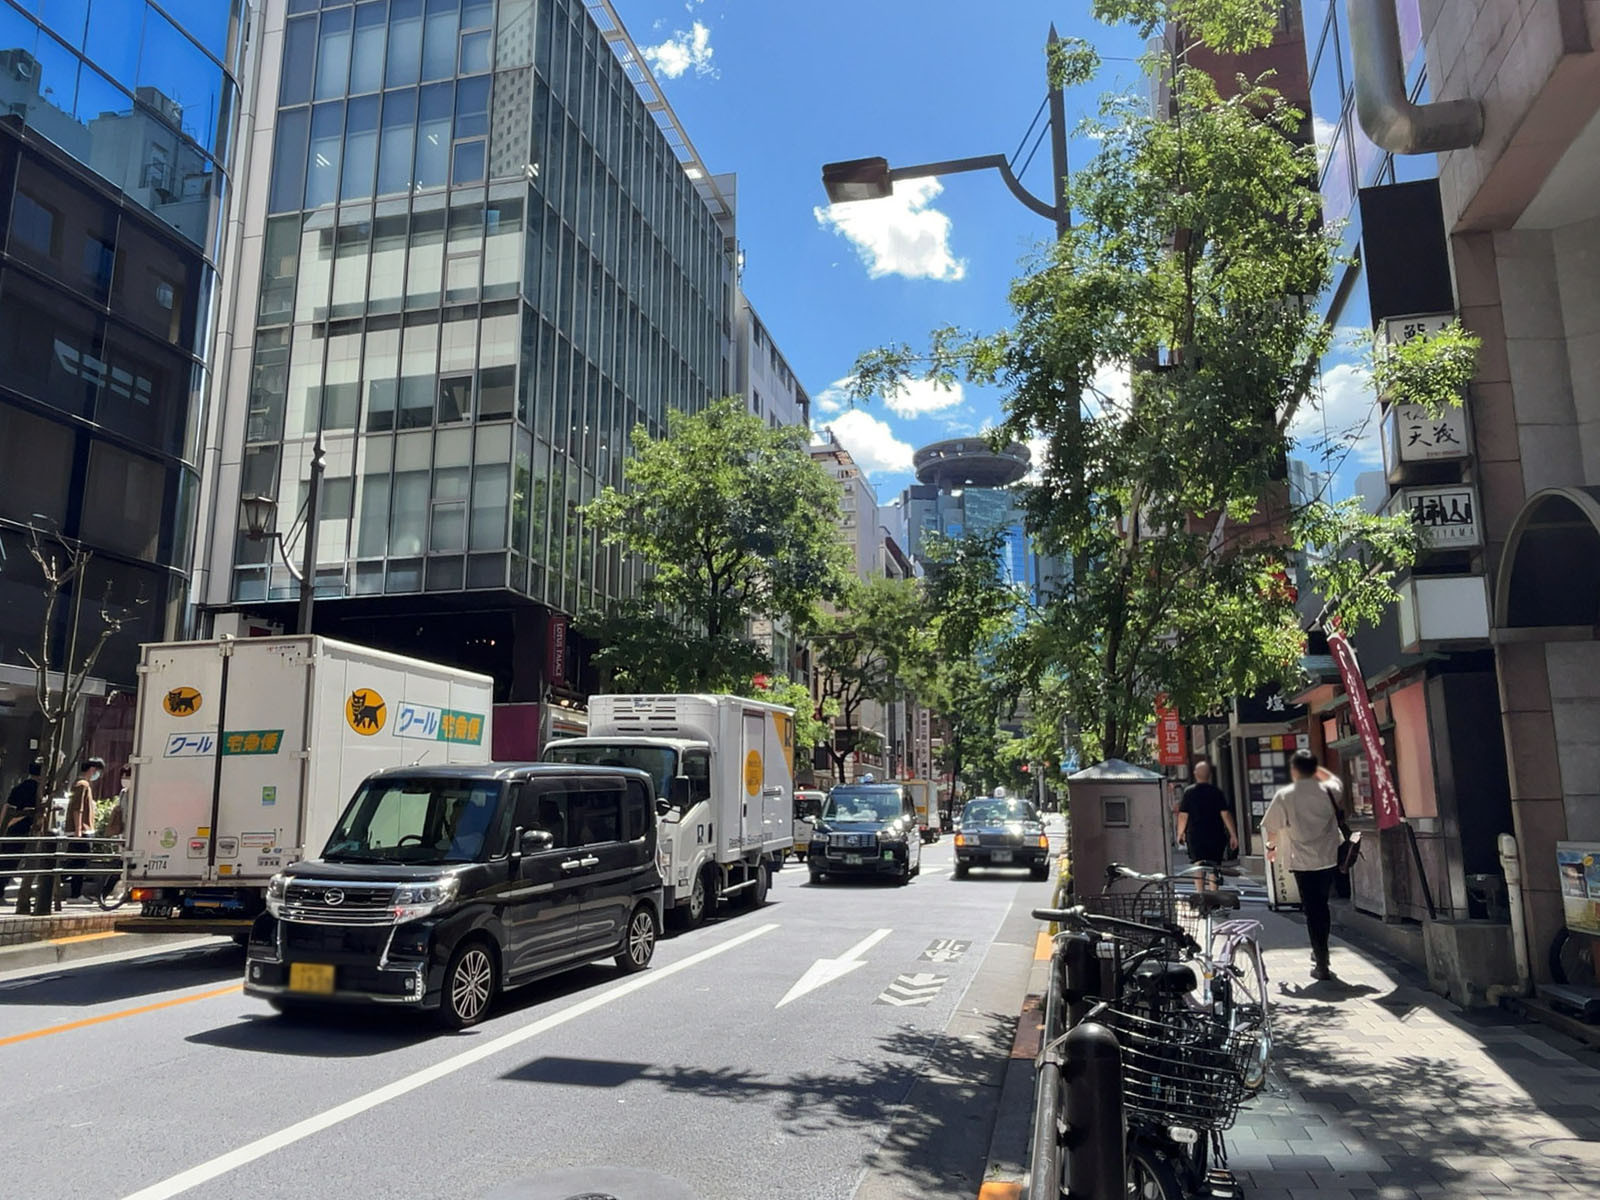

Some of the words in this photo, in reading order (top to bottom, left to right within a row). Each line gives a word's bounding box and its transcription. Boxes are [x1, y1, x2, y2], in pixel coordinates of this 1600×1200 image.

[400, 708, 439, 737] クール
[441, 714, 482, 741] 宅急便
[168, 734, 215, 754] クール
[226, 731, 279, 754] 宅急便
